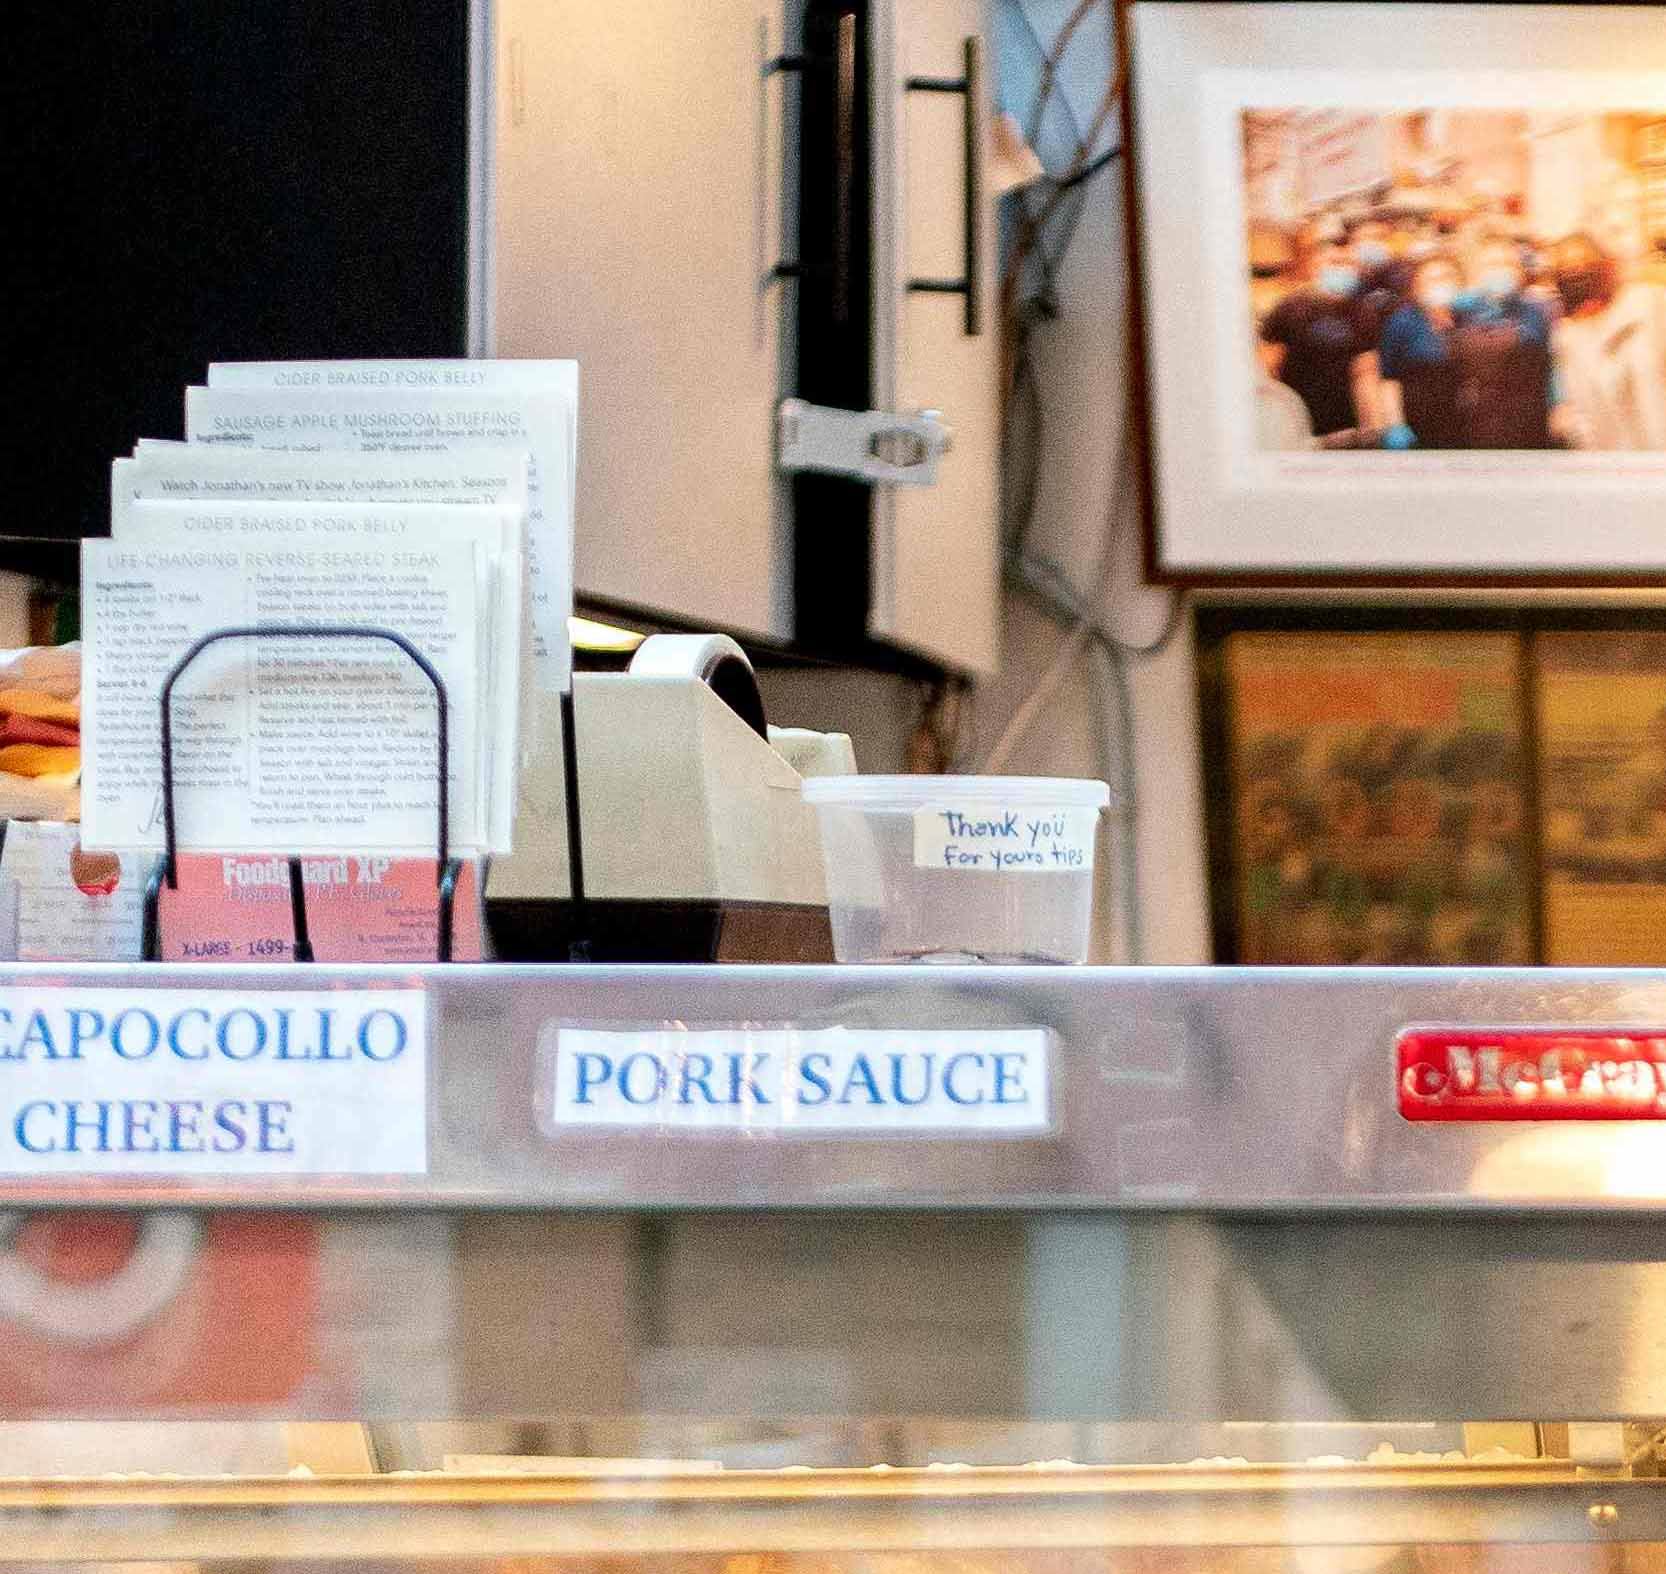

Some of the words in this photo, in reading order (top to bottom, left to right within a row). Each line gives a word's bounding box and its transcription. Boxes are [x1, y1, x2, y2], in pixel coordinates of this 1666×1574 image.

[327, 371, 390, 385] BRAISED
[396, 371, 438, 385] PORK
[443, 372, 488, 385] BELLY
[213, 414, 285, 430] SAUSAGE
[291, 414, 337, 429] APPLE
[343, 413, 440, 428] MUSHROOM
[447, 413, 521, 427] STUFFING
[183, 516, 234, 533] CIDER
[239, 516, 306, 532] BRAISED
[311, 516, 356, 532] PORK
[363, 517, 408, 533] BELLY
[106, 552, 239, 570] LIFE-CHANGING
[391, 551, 441, 567] STEAK
[939, 810, 1021, 840] Thank
[944, 845, 985, 866] For
[1050, 844, 1085, 867] tips
[572, 1051, 772, 1106] PORK
[797, 1052, 1029, 1106] SAUCE
[13, 1099, 296, 1154] CHEESE
